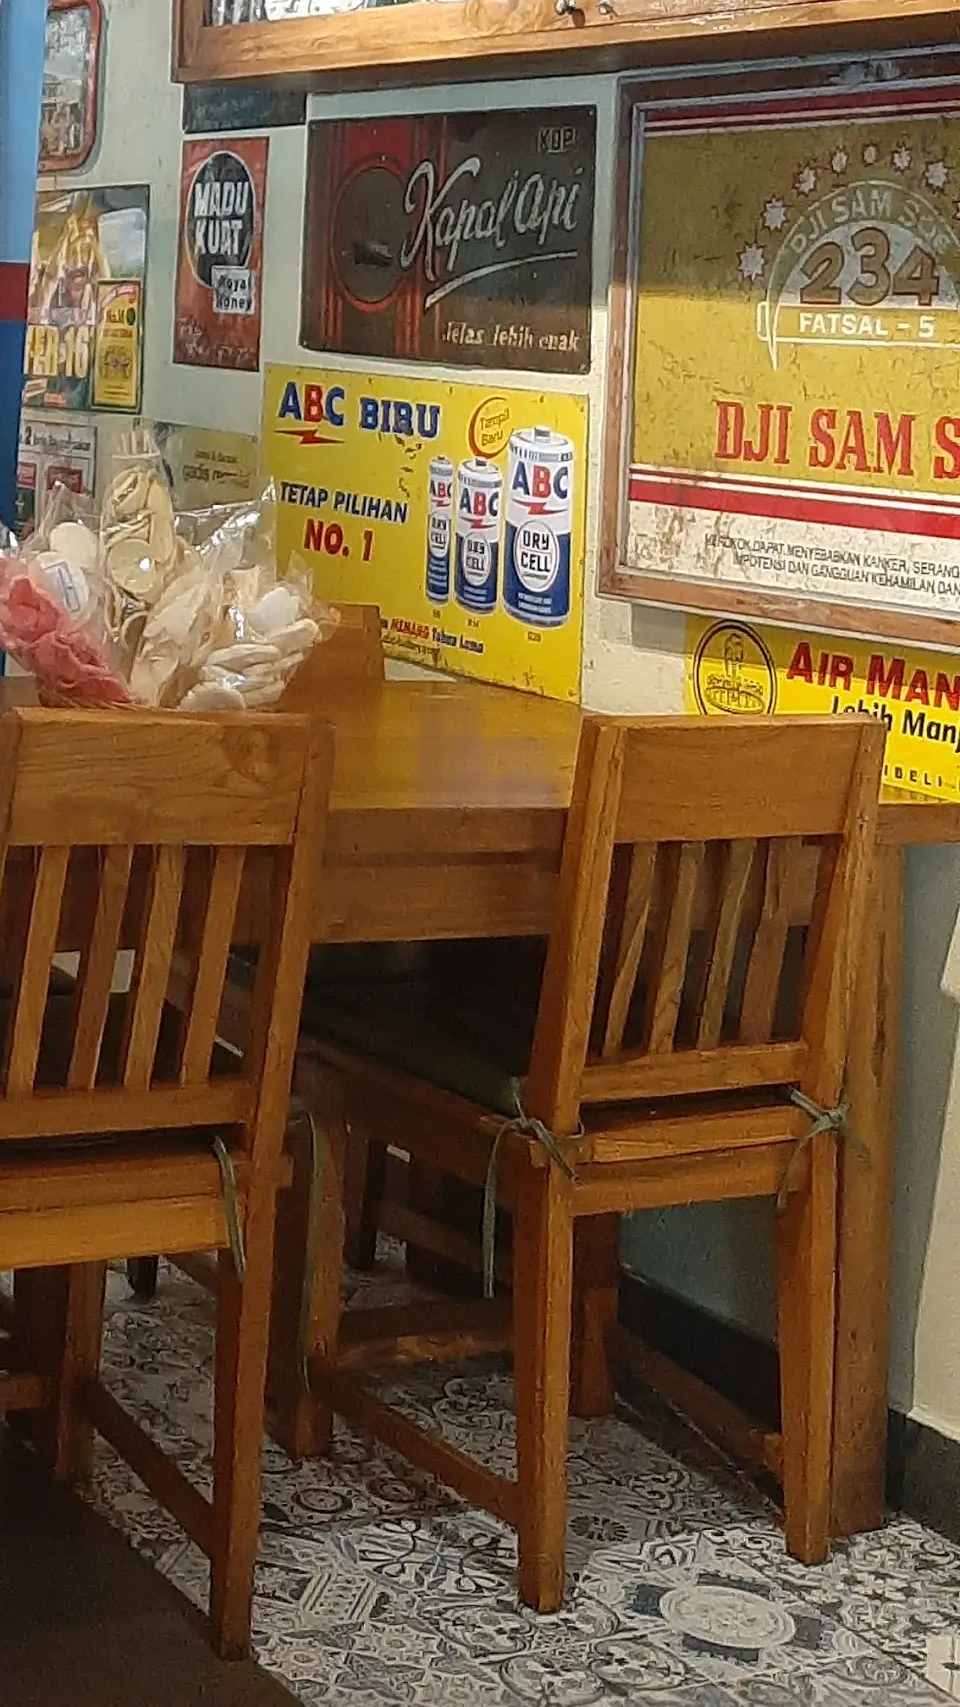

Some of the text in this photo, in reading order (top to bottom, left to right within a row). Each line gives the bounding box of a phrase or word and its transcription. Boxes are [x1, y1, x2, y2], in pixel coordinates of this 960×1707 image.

[194, 182, 249, 217] MADU
[831, 189, 890, 224] SAM
[400, 157, 583, 282] Kapal Api
[195, 220, 243, 255] KUAT
[799, 226, 940, 307] 234
[493, 324, 533, 349] lebih
[799, 312, 888, 335] FATSAL
[918, 315, 935, 338] 5
[278, 381, 441, 438] ABC BIRU
[714, 400, 793, 465] DJI
[808, 408, 916, 477] SAM
[512, 461, 568, 499] ABC
[280, 481, 408, 523] TETAP PILIHAN
[459, 488, 499, 517] ABC
[304, 518, 374, 563] NO. 1
[467, 539, 485, 555] DRY
[523, 529, 550, 551] DRY
[466, 554, 485, 572] CELL
[521, 551, 551, 573] CELL
[787, 642, 855, 692] AIR
